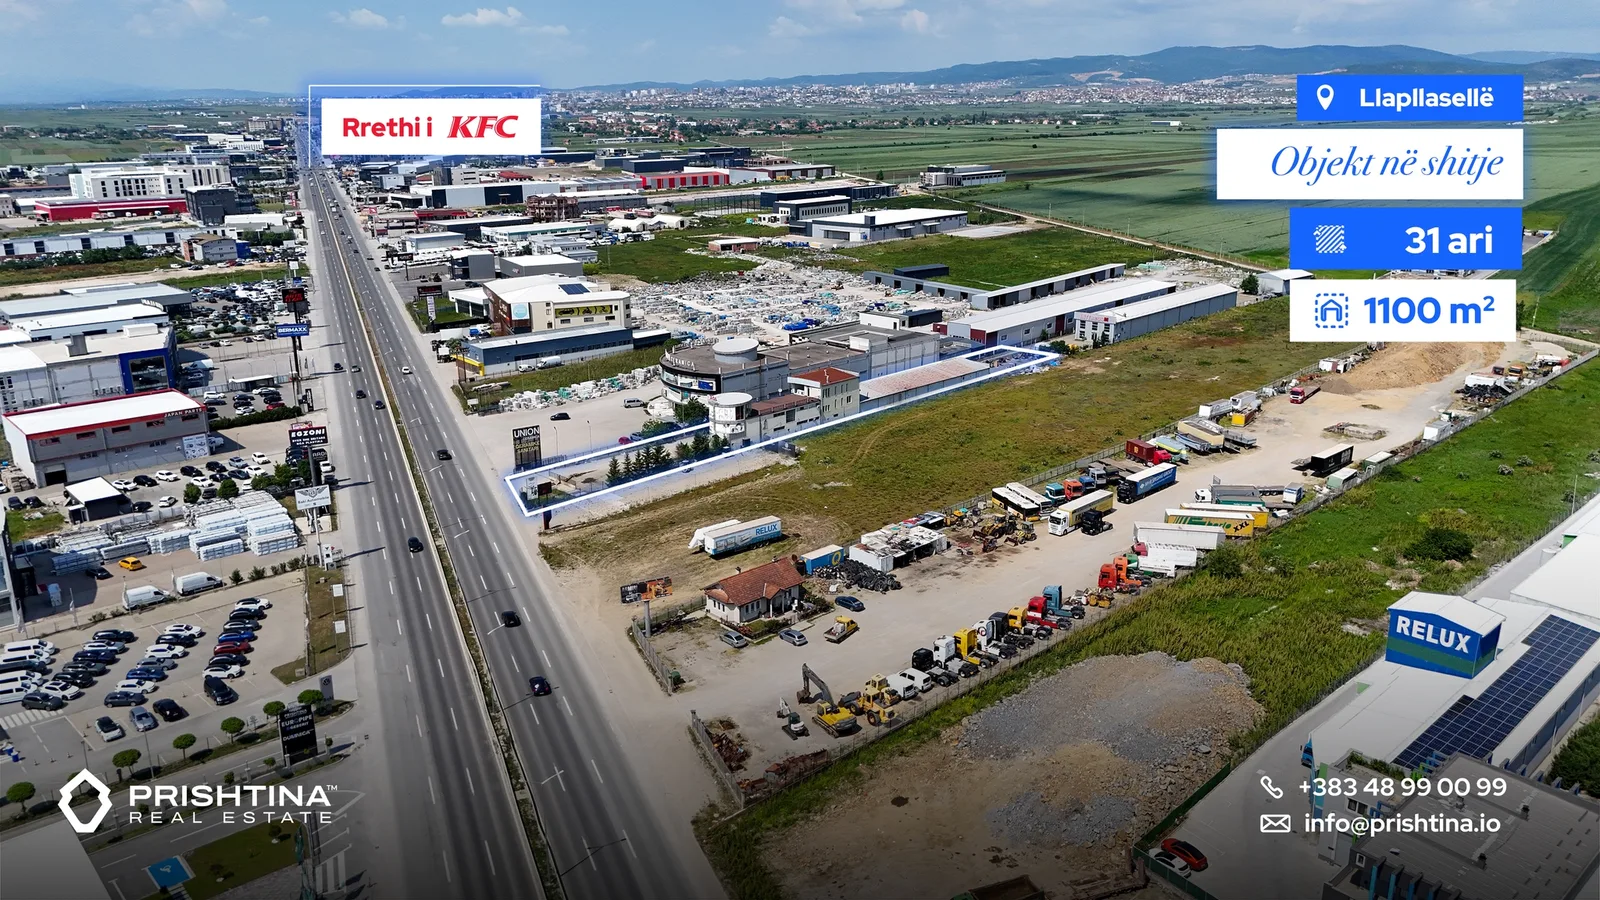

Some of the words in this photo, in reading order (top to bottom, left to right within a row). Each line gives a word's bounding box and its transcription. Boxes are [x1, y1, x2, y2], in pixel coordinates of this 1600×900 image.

[291, 428, 325, 438] EGZONI
[513, 427, 540, 438] UNION
[756, 524, 778, 536] RELUX
[1233, 520, 1250, 533] XXL
[1396, 615, 1471, 654] RELUX
